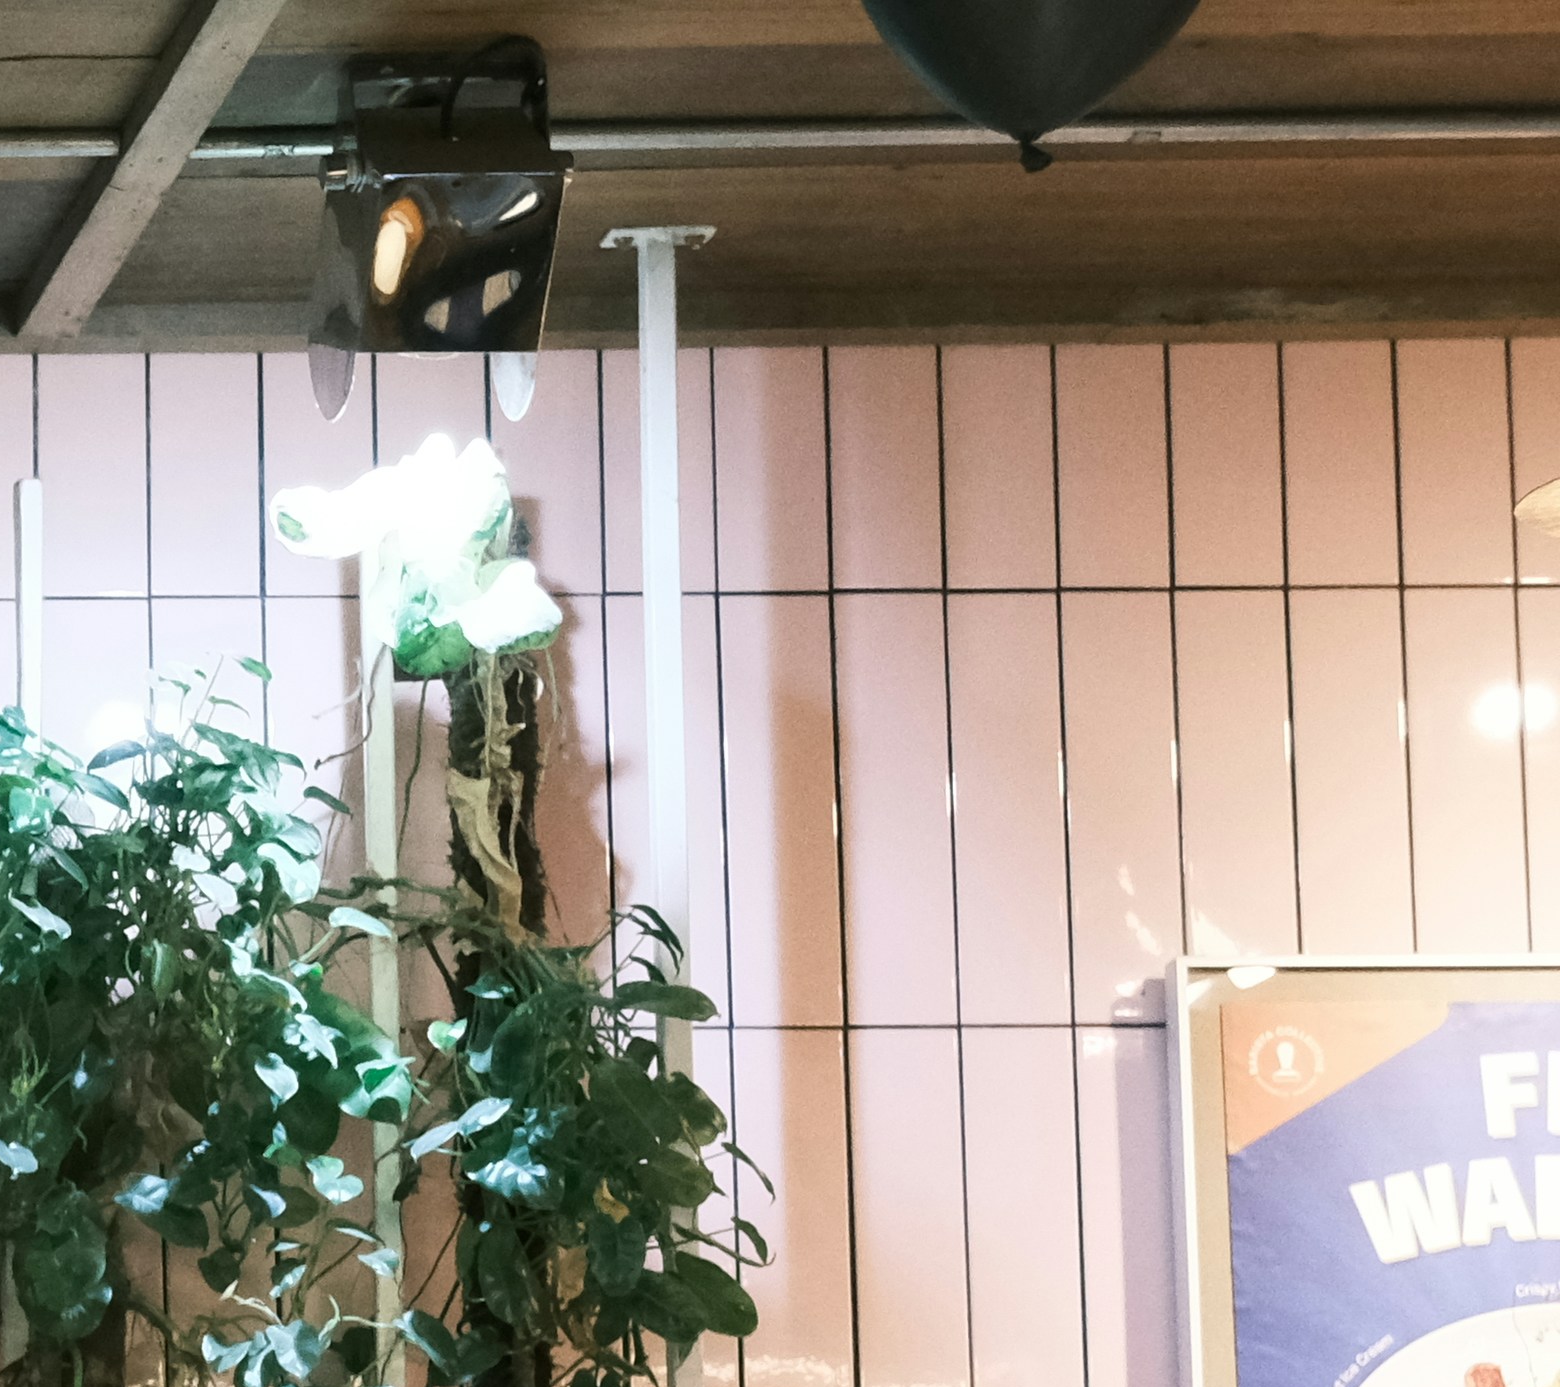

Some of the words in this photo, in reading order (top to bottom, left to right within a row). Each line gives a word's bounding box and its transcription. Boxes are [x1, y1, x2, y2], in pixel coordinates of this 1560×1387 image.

[1479, 1050, 1560, 1140] F
[1339, 1362, 1361, 1383] Ice
[1355, 1333, 1395, 1368] Cream
